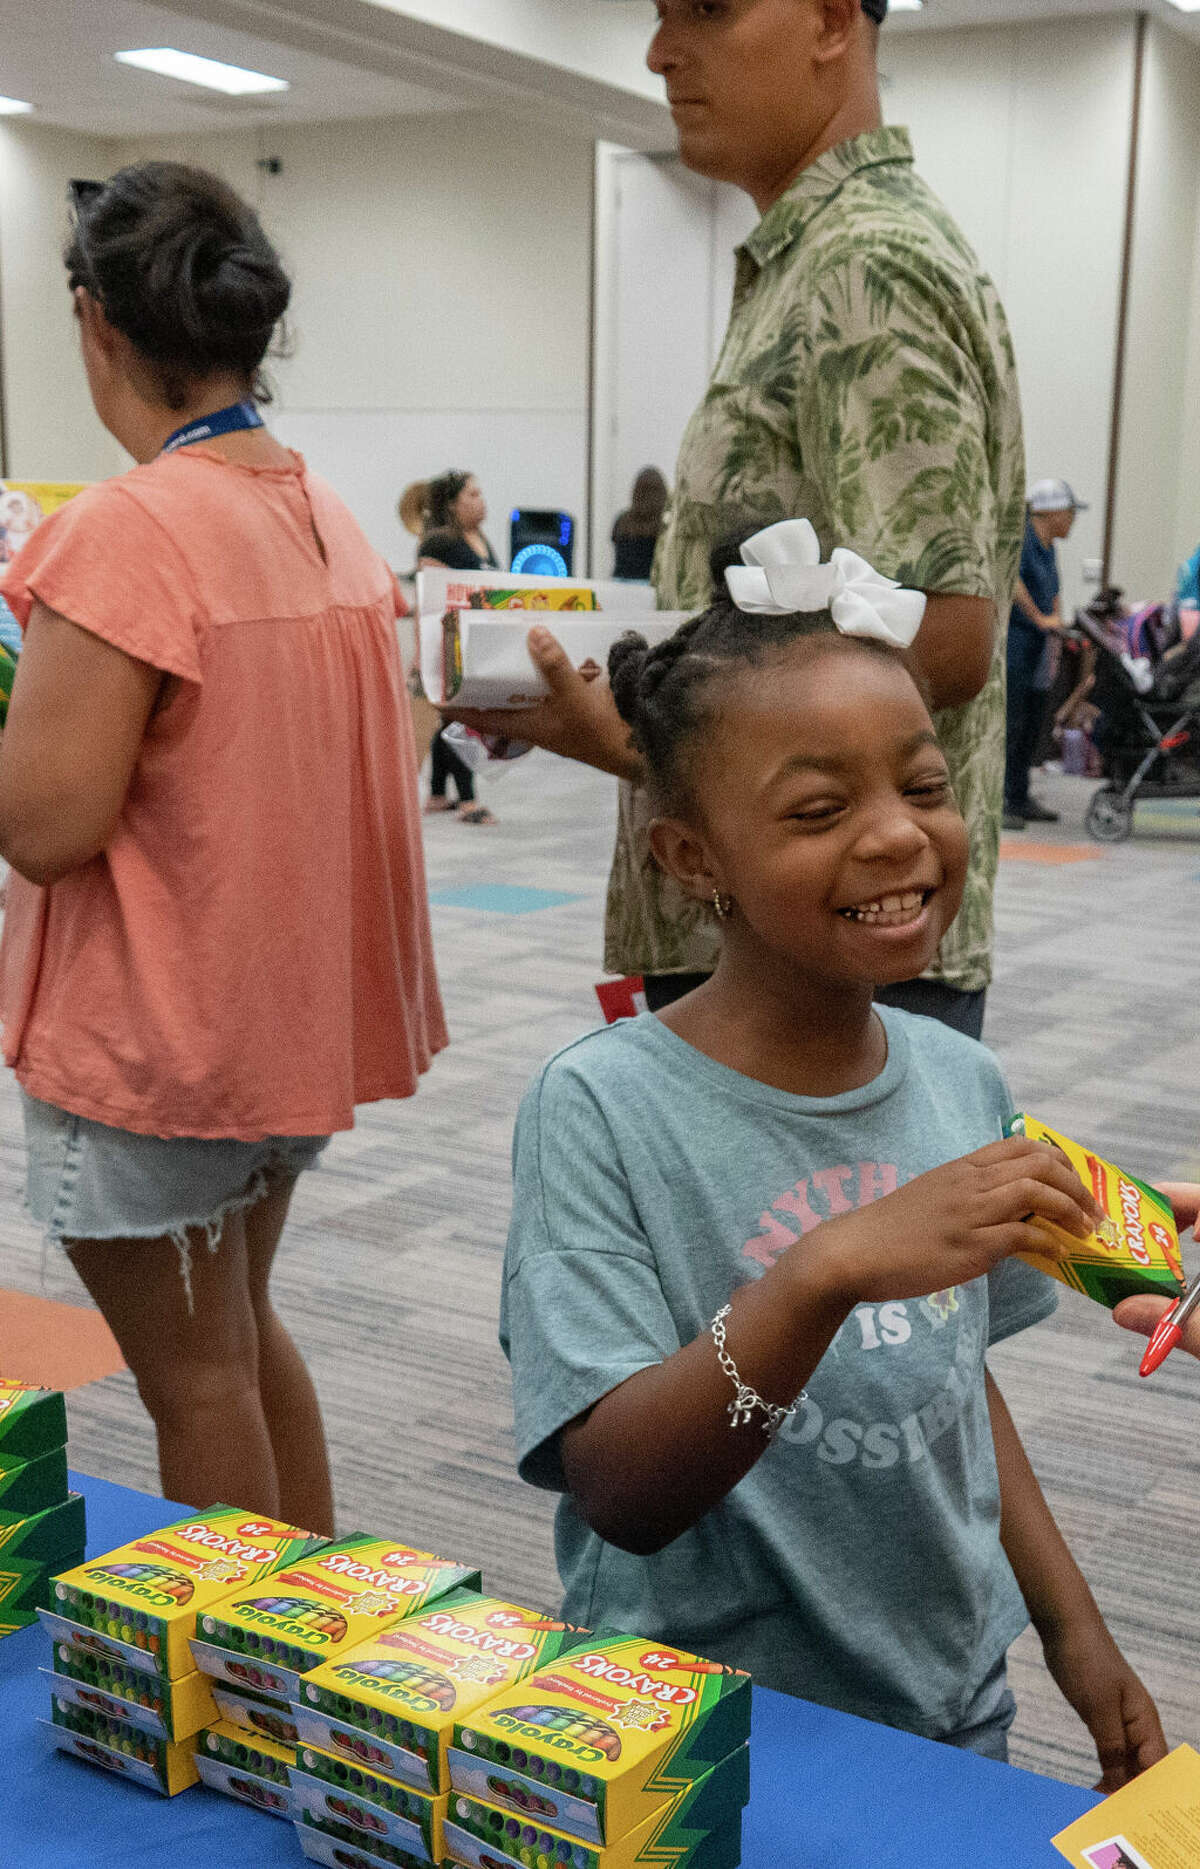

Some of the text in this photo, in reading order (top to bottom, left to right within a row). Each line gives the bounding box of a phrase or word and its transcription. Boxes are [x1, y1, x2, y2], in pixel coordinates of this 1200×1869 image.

[741, 1161, 899, 1268] NYTH
[1119, 1180, 1150, 1265] CRAYONS
[1151, 1224, 1170, 1248] 24
[855, 1303, 912, 1350] IS
[176, 1525, 278, 1563] CRAYONS
[242, 1523, 269, 1536] 24
[321, 1554, 426, 1594] CRAYONS
[386, 1553, 412, 1566] 24
[85, 1570, 176, 1607] Crayola
[235, 1605, 329, 1645] Crayola
[420, 1614, 536, 1659] CRAYONS
[491, 1614, 521, 1627] 24
[574, 1655, 697, 1704] CRAYONS
[643, 1653, 676, 1668] 24
[336, 1669, 439, 1712] Crayola
[494, 1715, 604, 1762] Crayola
